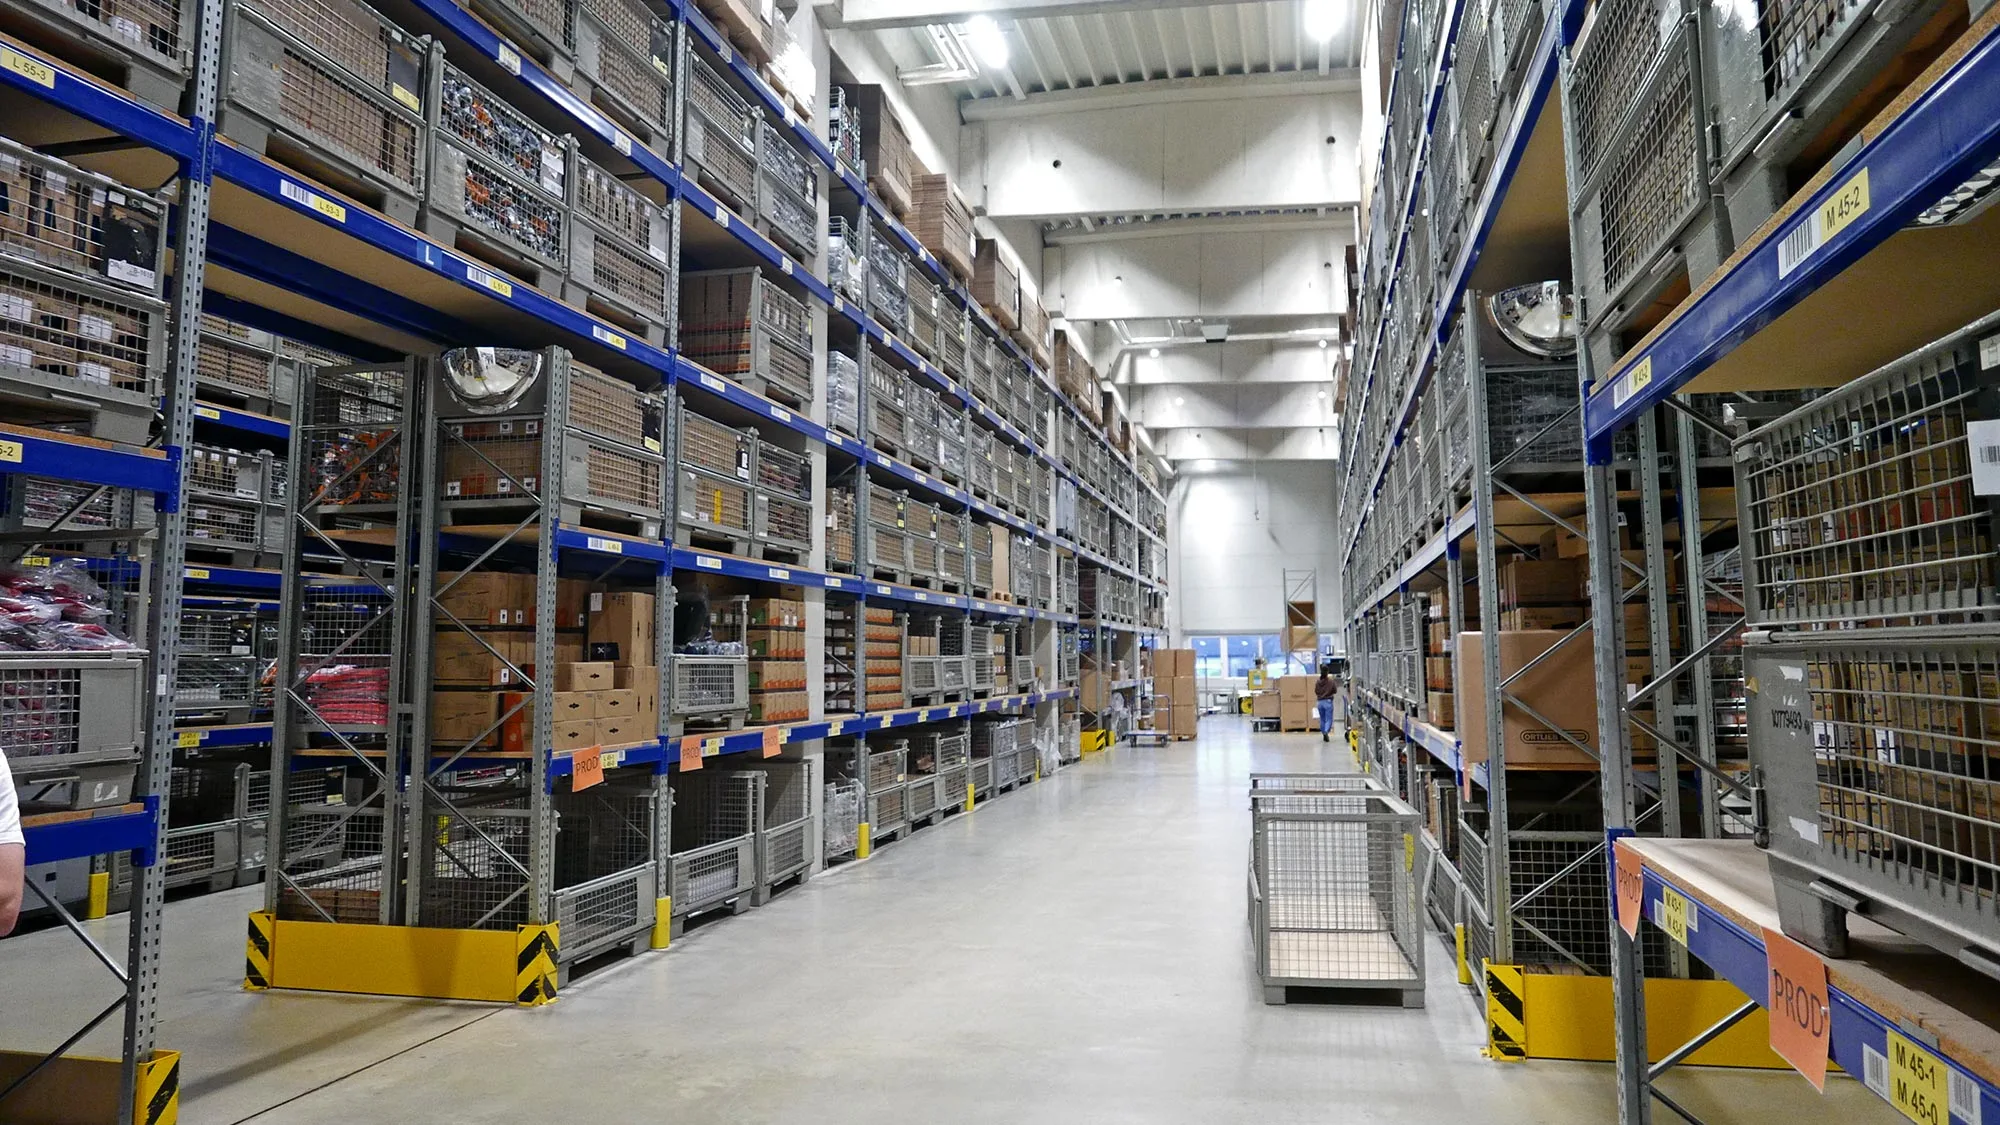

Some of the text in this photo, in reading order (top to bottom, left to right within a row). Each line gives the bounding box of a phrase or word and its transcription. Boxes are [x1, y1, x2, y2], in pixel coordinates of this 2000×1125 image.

[13, 57, 46, 81] L 55-3
[319, 200, 325, 210] L
[1826, 185, 1860, 231] M 45-2
[425, 245, 434, 265] L
[575, 755, 600, 777] PROD
[1617, 864, 1642, 904] PROD
[1665, 890, 1671, 908] M
[1666, 912, 1672, 930] M
[1773, 968, 1825, 1038] PROD
[1895, 1041, 1936, 1090] M 45-1
[1896, 1077, 1939, 1125] M 45-0
